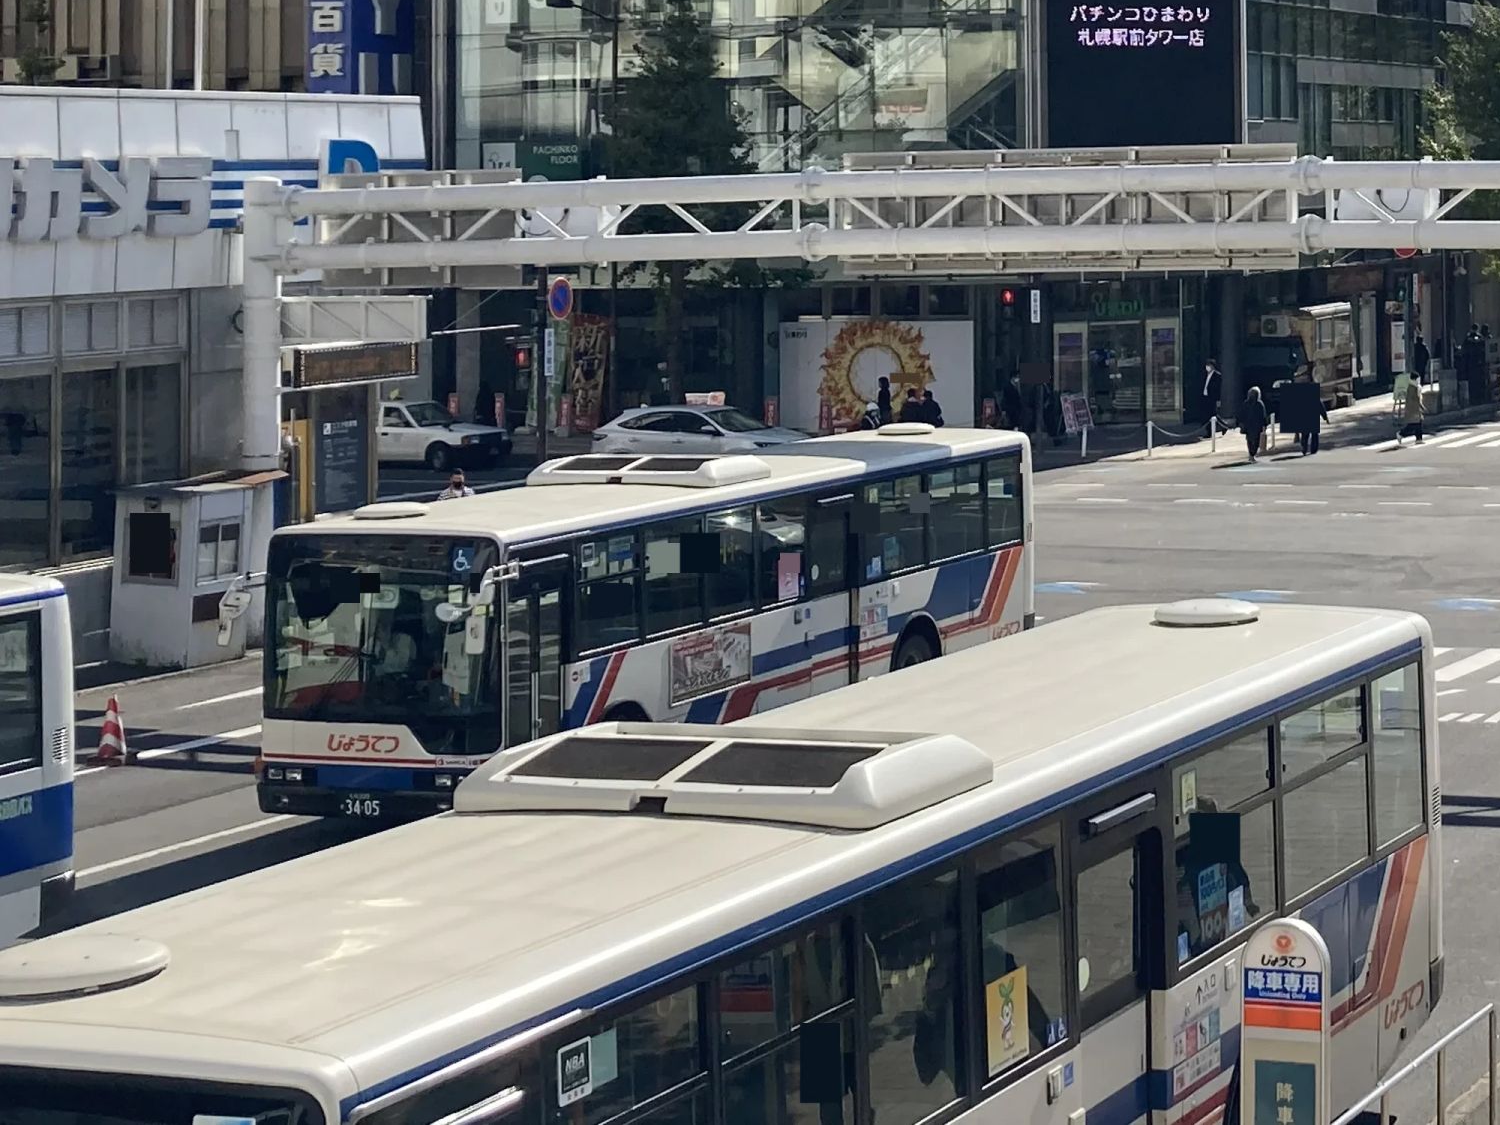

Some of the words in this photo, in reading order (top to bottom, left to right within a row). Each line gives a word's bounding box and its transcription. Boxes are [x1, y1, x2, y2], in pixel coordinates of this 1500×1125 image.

[1069, 4, 1211, 23] パチンコひまわり
[1077, 27, 1206, 48] 札幌駅前タワー店
[532, 144, 579, 155] PACHINKO
[550, 154, 579, 164] FLOOR
[327, 733, 400, 754] じょうてつ
[1261, 954, 1307, 969] じょうてつ
[1247, 970, 1320, 994] 降車専用
[1384, 978, 1425, 1030] じょうてつ
[565, 1052, 585, 1074] NBA
[1275, 1081, 1294, 1125] 降車
